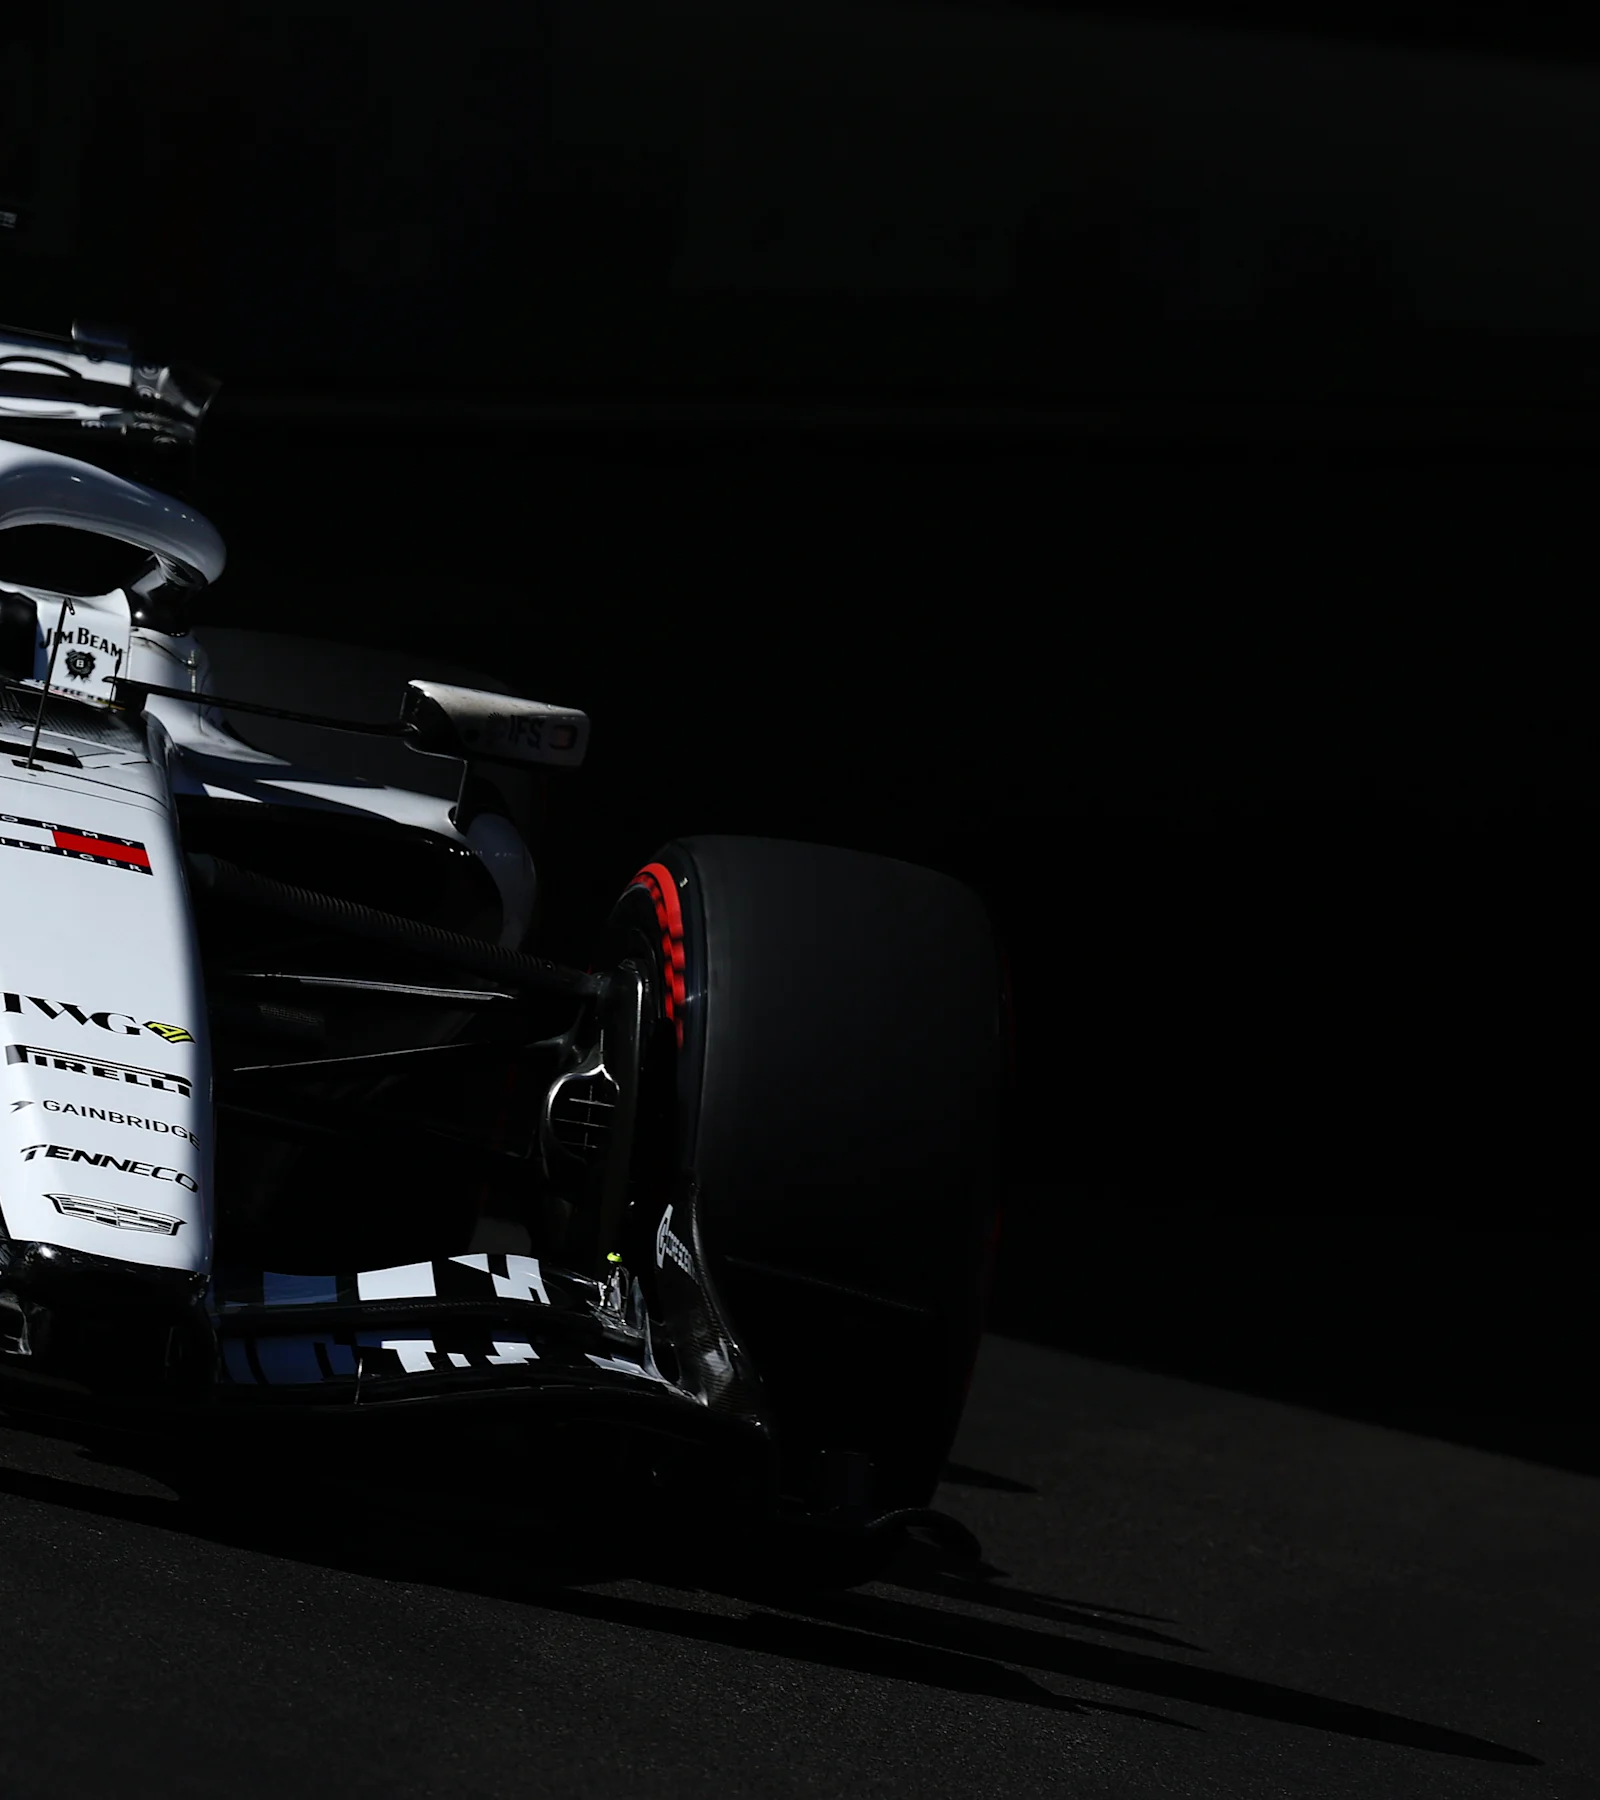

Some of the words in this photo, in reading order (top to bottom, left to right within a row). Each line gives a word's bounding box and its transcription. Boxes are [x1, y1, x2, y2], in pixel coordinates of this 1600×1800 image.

[77, 627, 123, 658] BEAM
[5, 1044, 194, 1099] PIRELLI
[42, 1099, 201, 1149] GAINBRIDGE
[19, 1143, 199, 1194] TENNECO
